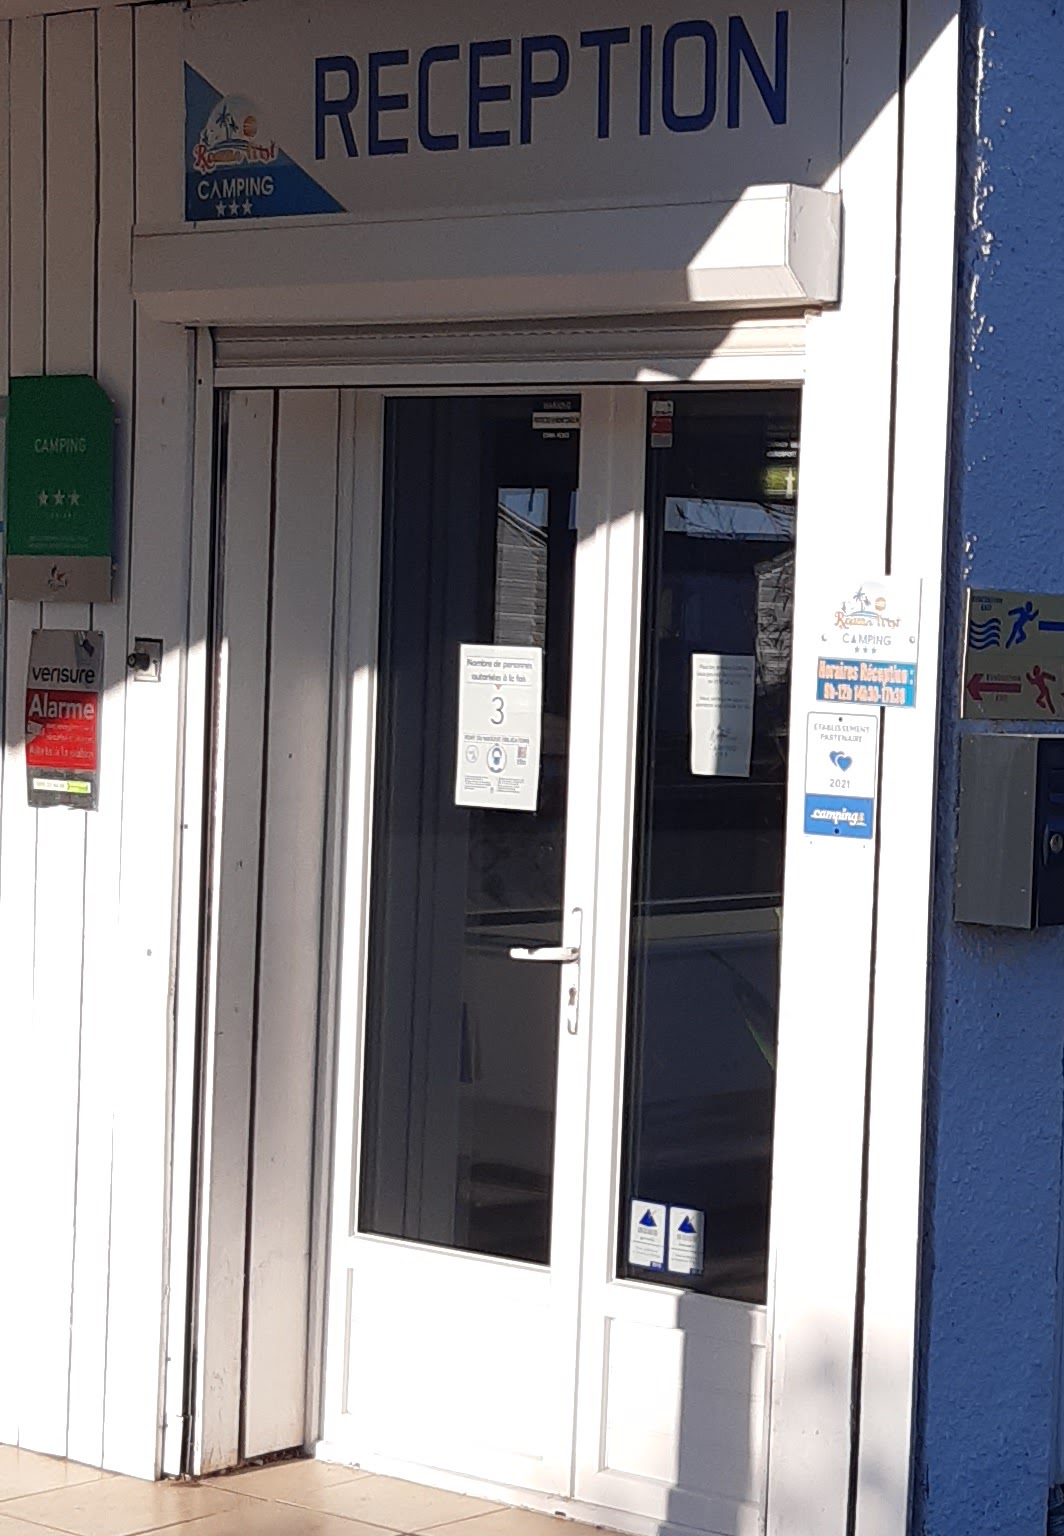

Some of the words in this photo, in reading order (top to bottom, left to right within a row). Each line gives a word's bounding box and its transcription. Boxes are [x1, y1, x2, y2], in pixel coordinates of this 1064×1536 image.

[315, 10, 789, 160] RECEPTION
[197, 175, 275, 201] CAMPING
[34, 438, 87, 454] CAMPING
[842, 632, 892, 646] CAMPING
[32, 666, 96, 684] verisure
[29, 692, 95, 721] Alarme
[490, 696, 505, 725] 3
[829, 778, 851, 789] 2021
